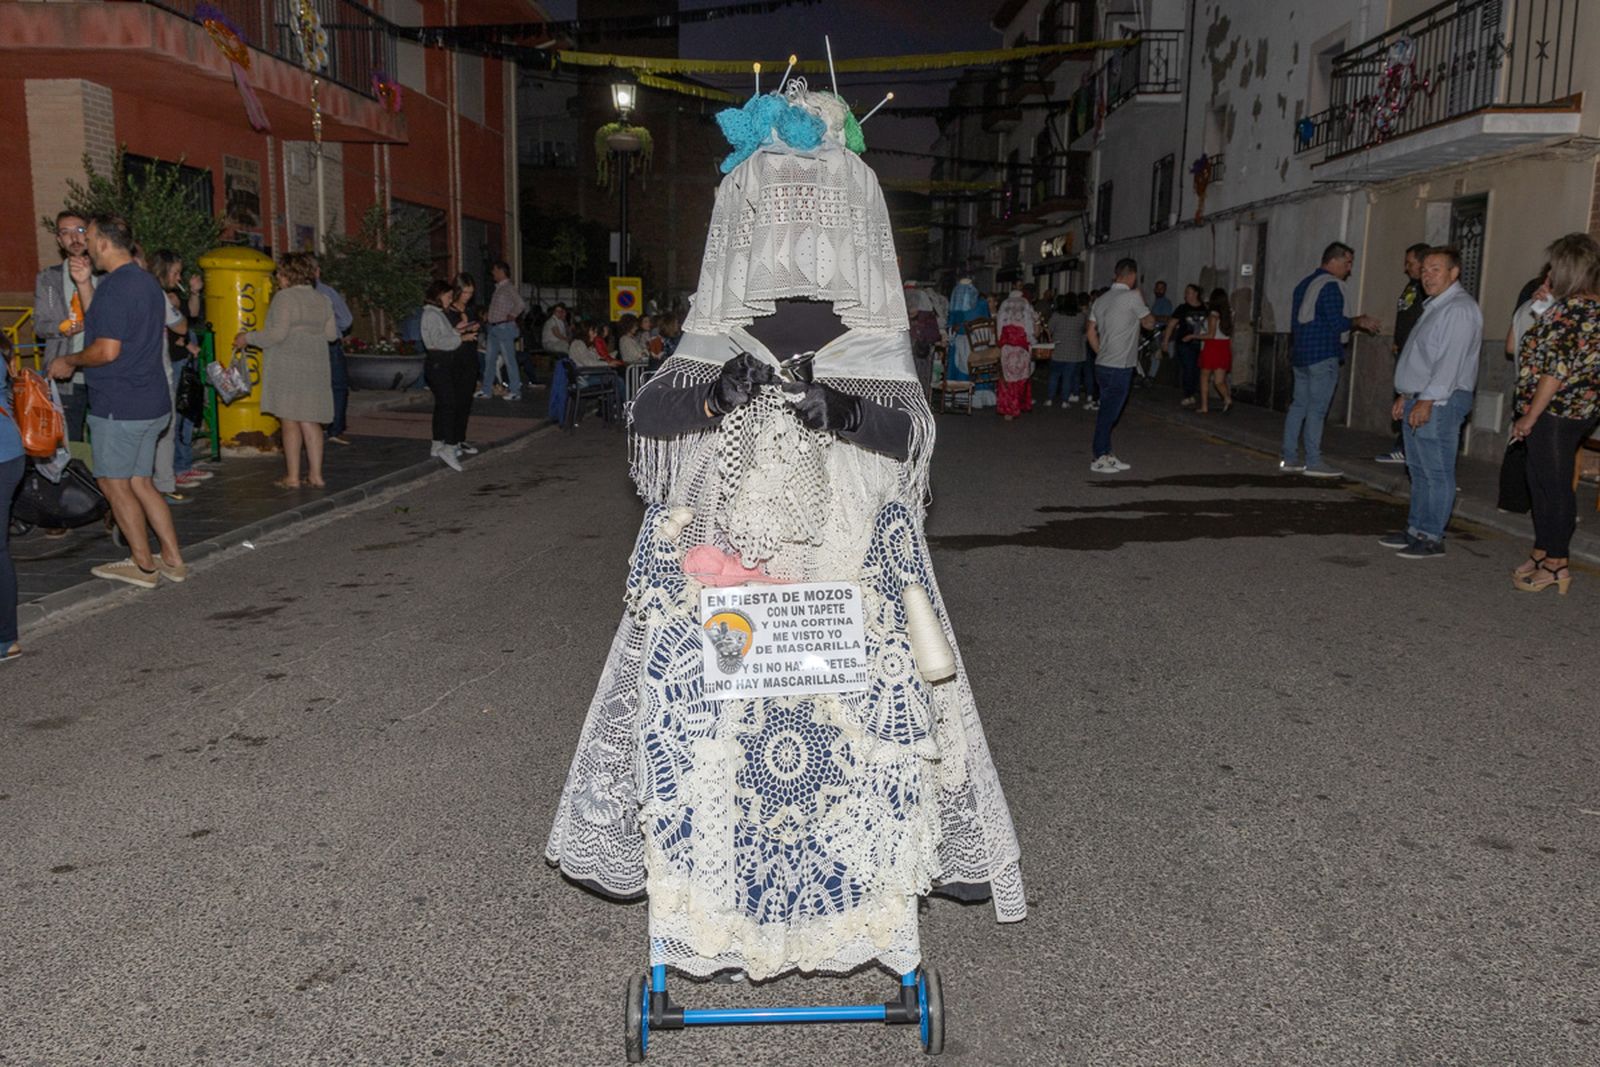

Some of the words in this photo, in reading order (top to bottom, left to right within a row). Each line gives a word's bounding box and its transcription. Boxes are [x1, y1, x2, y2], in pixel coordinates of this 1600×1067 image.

[708, 596, 725, 607] EN
[732, 593, 777, 606] FIESTA
[783, 591, 799, 602] DE
[804, 589, 853, 602] MOZOS
[768, 606, 788, 618] CON
[792, 605, 805, 616] UN
[810, 604, 845, 615] TAPETE
[773, 620, 797, 628] UNA
[801, 617, 853, 627] CORTINA
[773, 632, 788, 641] ME
[793, 631, 824, 641] VISTO
[829, 629, 842, 639] YO
[756, 645, 772, 654] DE
[777, 640, 860, 653] MASCARILLA
[743, 664, 749, 674] Y
[753, 664, 763, 673] SI
[766, 662, 781, 672] NO
[736, 679, 759, 690] HAY
